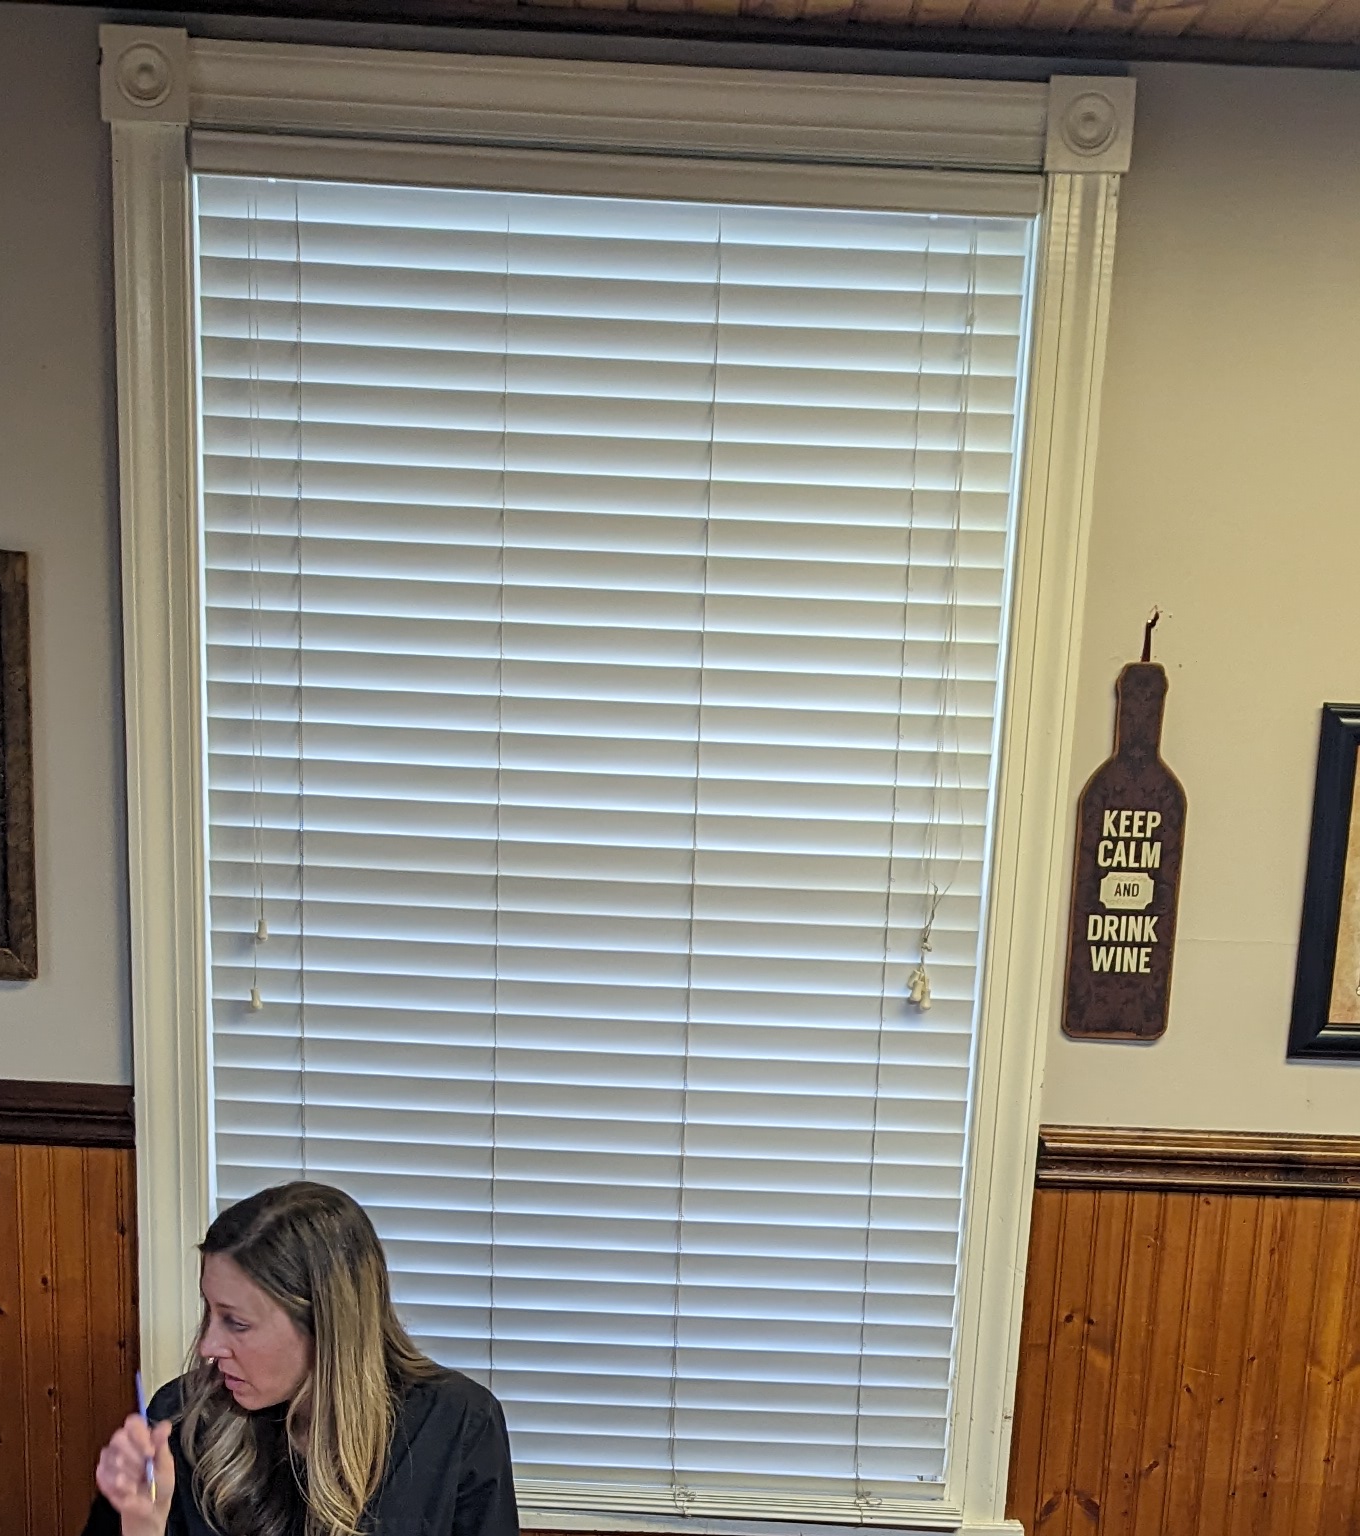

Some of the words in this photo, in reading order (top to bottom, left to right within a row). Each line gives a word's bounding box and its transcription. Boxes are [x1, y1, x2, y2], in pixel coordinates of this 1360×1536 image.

[1102, 809, 1162, 837] KEEP
[1097, 840, 1162, 869] CALM
[1114, 882, 1140, 898] AND
[1086, 914, 1158, 943] DRINK
[1090, 945, 1153, 974] WINE
